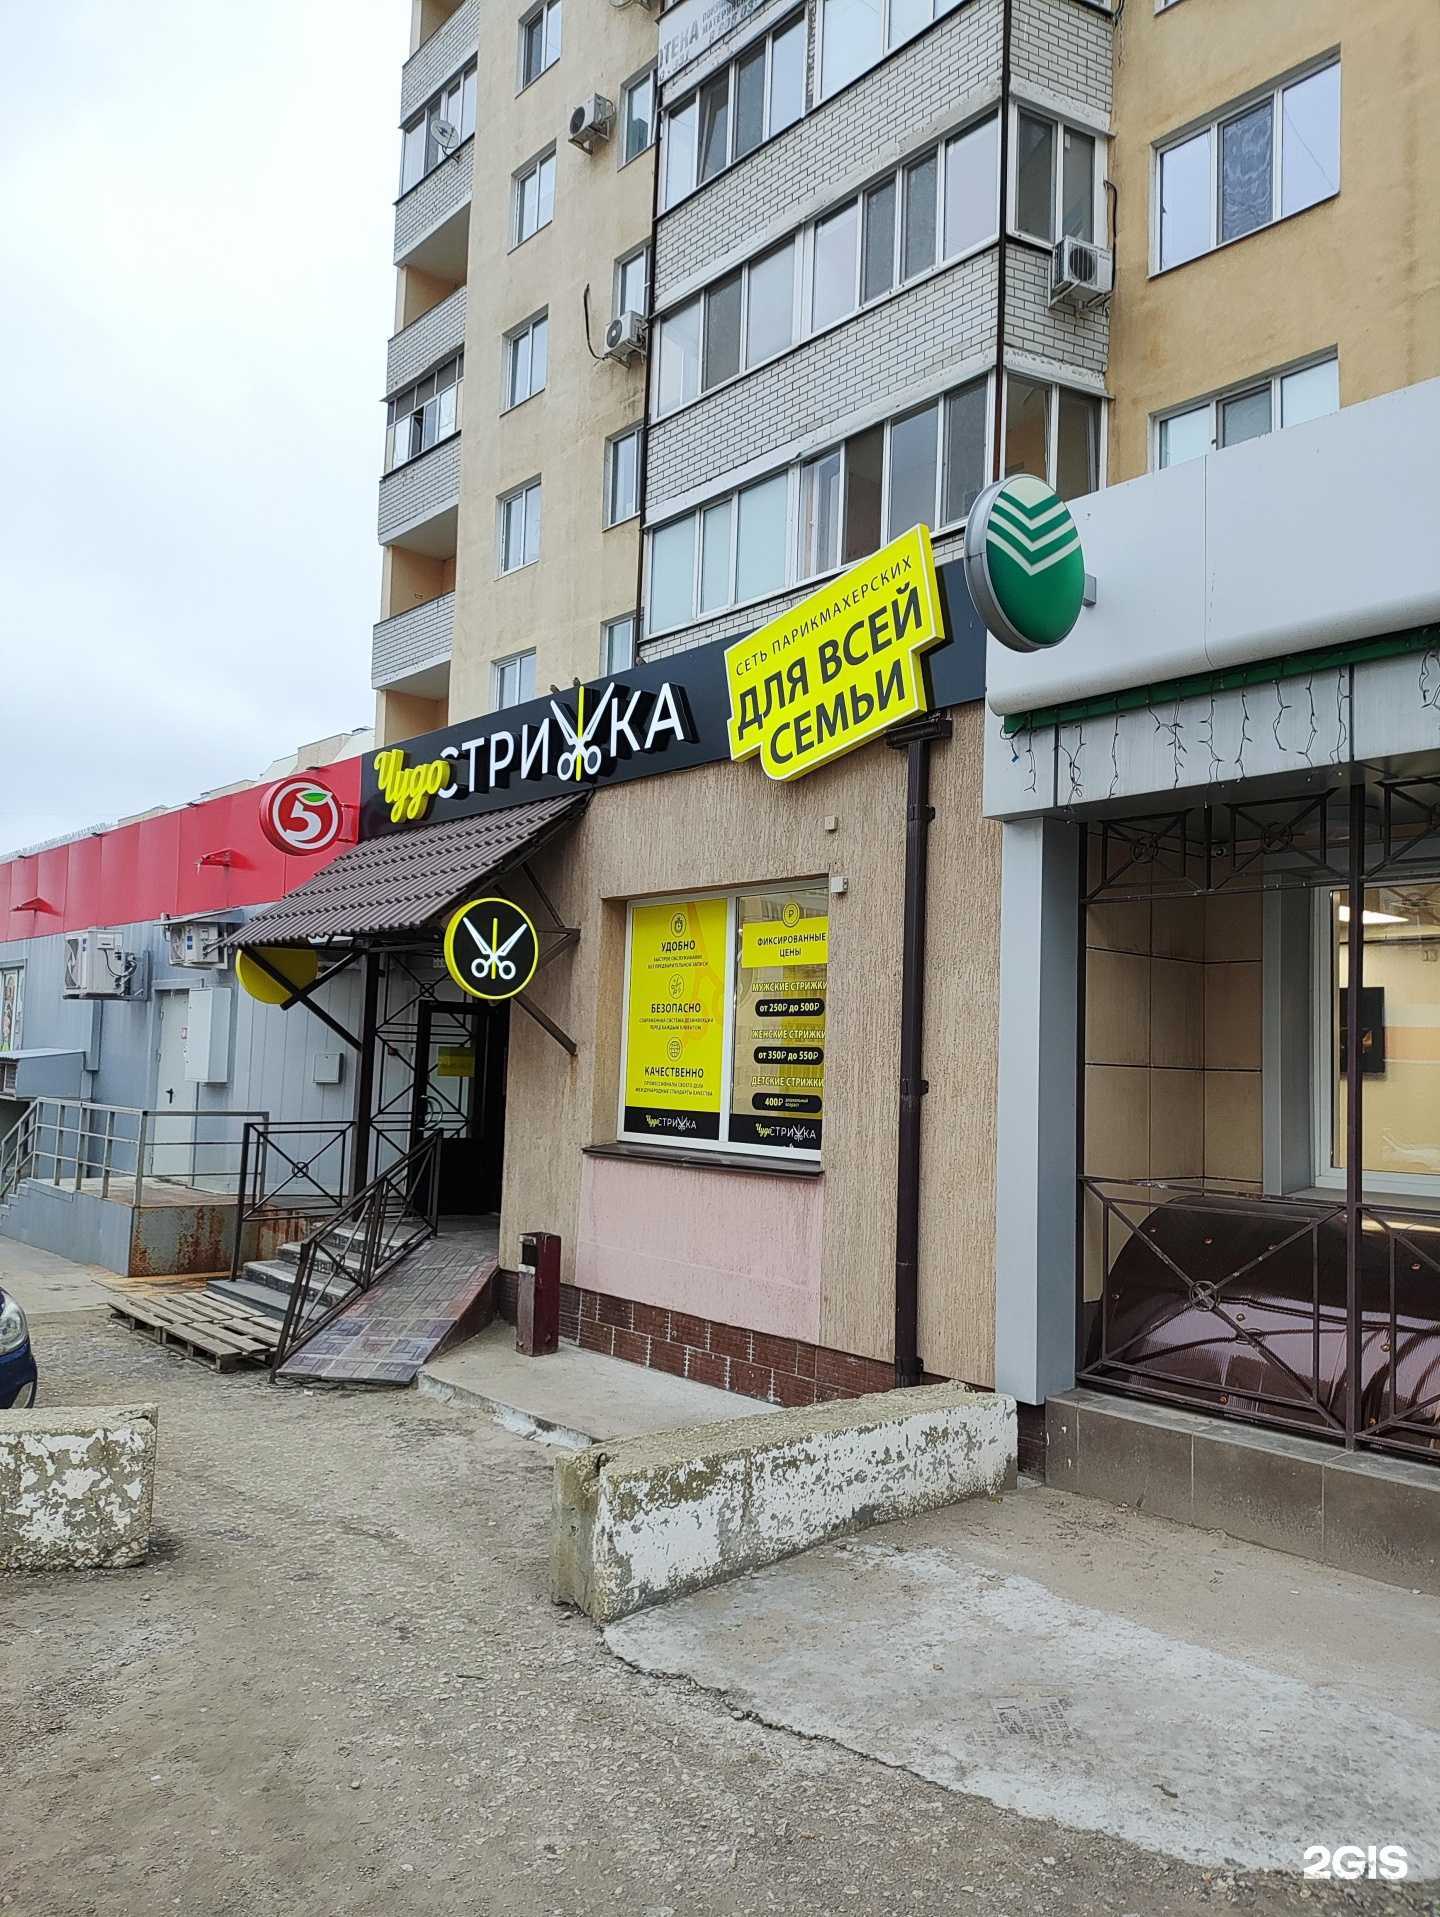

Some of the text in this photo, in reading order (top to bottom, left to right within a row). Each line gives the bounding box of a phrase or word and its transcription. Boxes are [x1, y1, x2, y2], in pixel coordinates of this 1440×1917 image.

[735, 555, 912, 676] СЕТЬ ПАРИКМАХЕРСКИХ
[738, 581, 923, 741] ДЛЯ ВСЕЙ
[769, 658, 906, 765] СЕМЬИ
[285, 799, 322, 841] 5
[757, 932, 826, 946] ФИКСИРОВАННЫЕ
[661, 940, 696, 953] УДОБНО
[779, 948, 802, 958] ЦЕНЫ
[752, 982, 789, 993] МУЖСКИЕ
[651, 1003, 701, 1014] БЕЗОПАСНО
[789, 1004, 799, 1013] до
[752, 1030, 788, 1040] ЖЕНСКИЕ
[788, 1052, 798, 1062] до
[644, 1066, 704, 1078] КАЧЕСТВЕННО
[752, 1076, 825, 1087] ДЕТСКИЕ СТРИЖКИ
